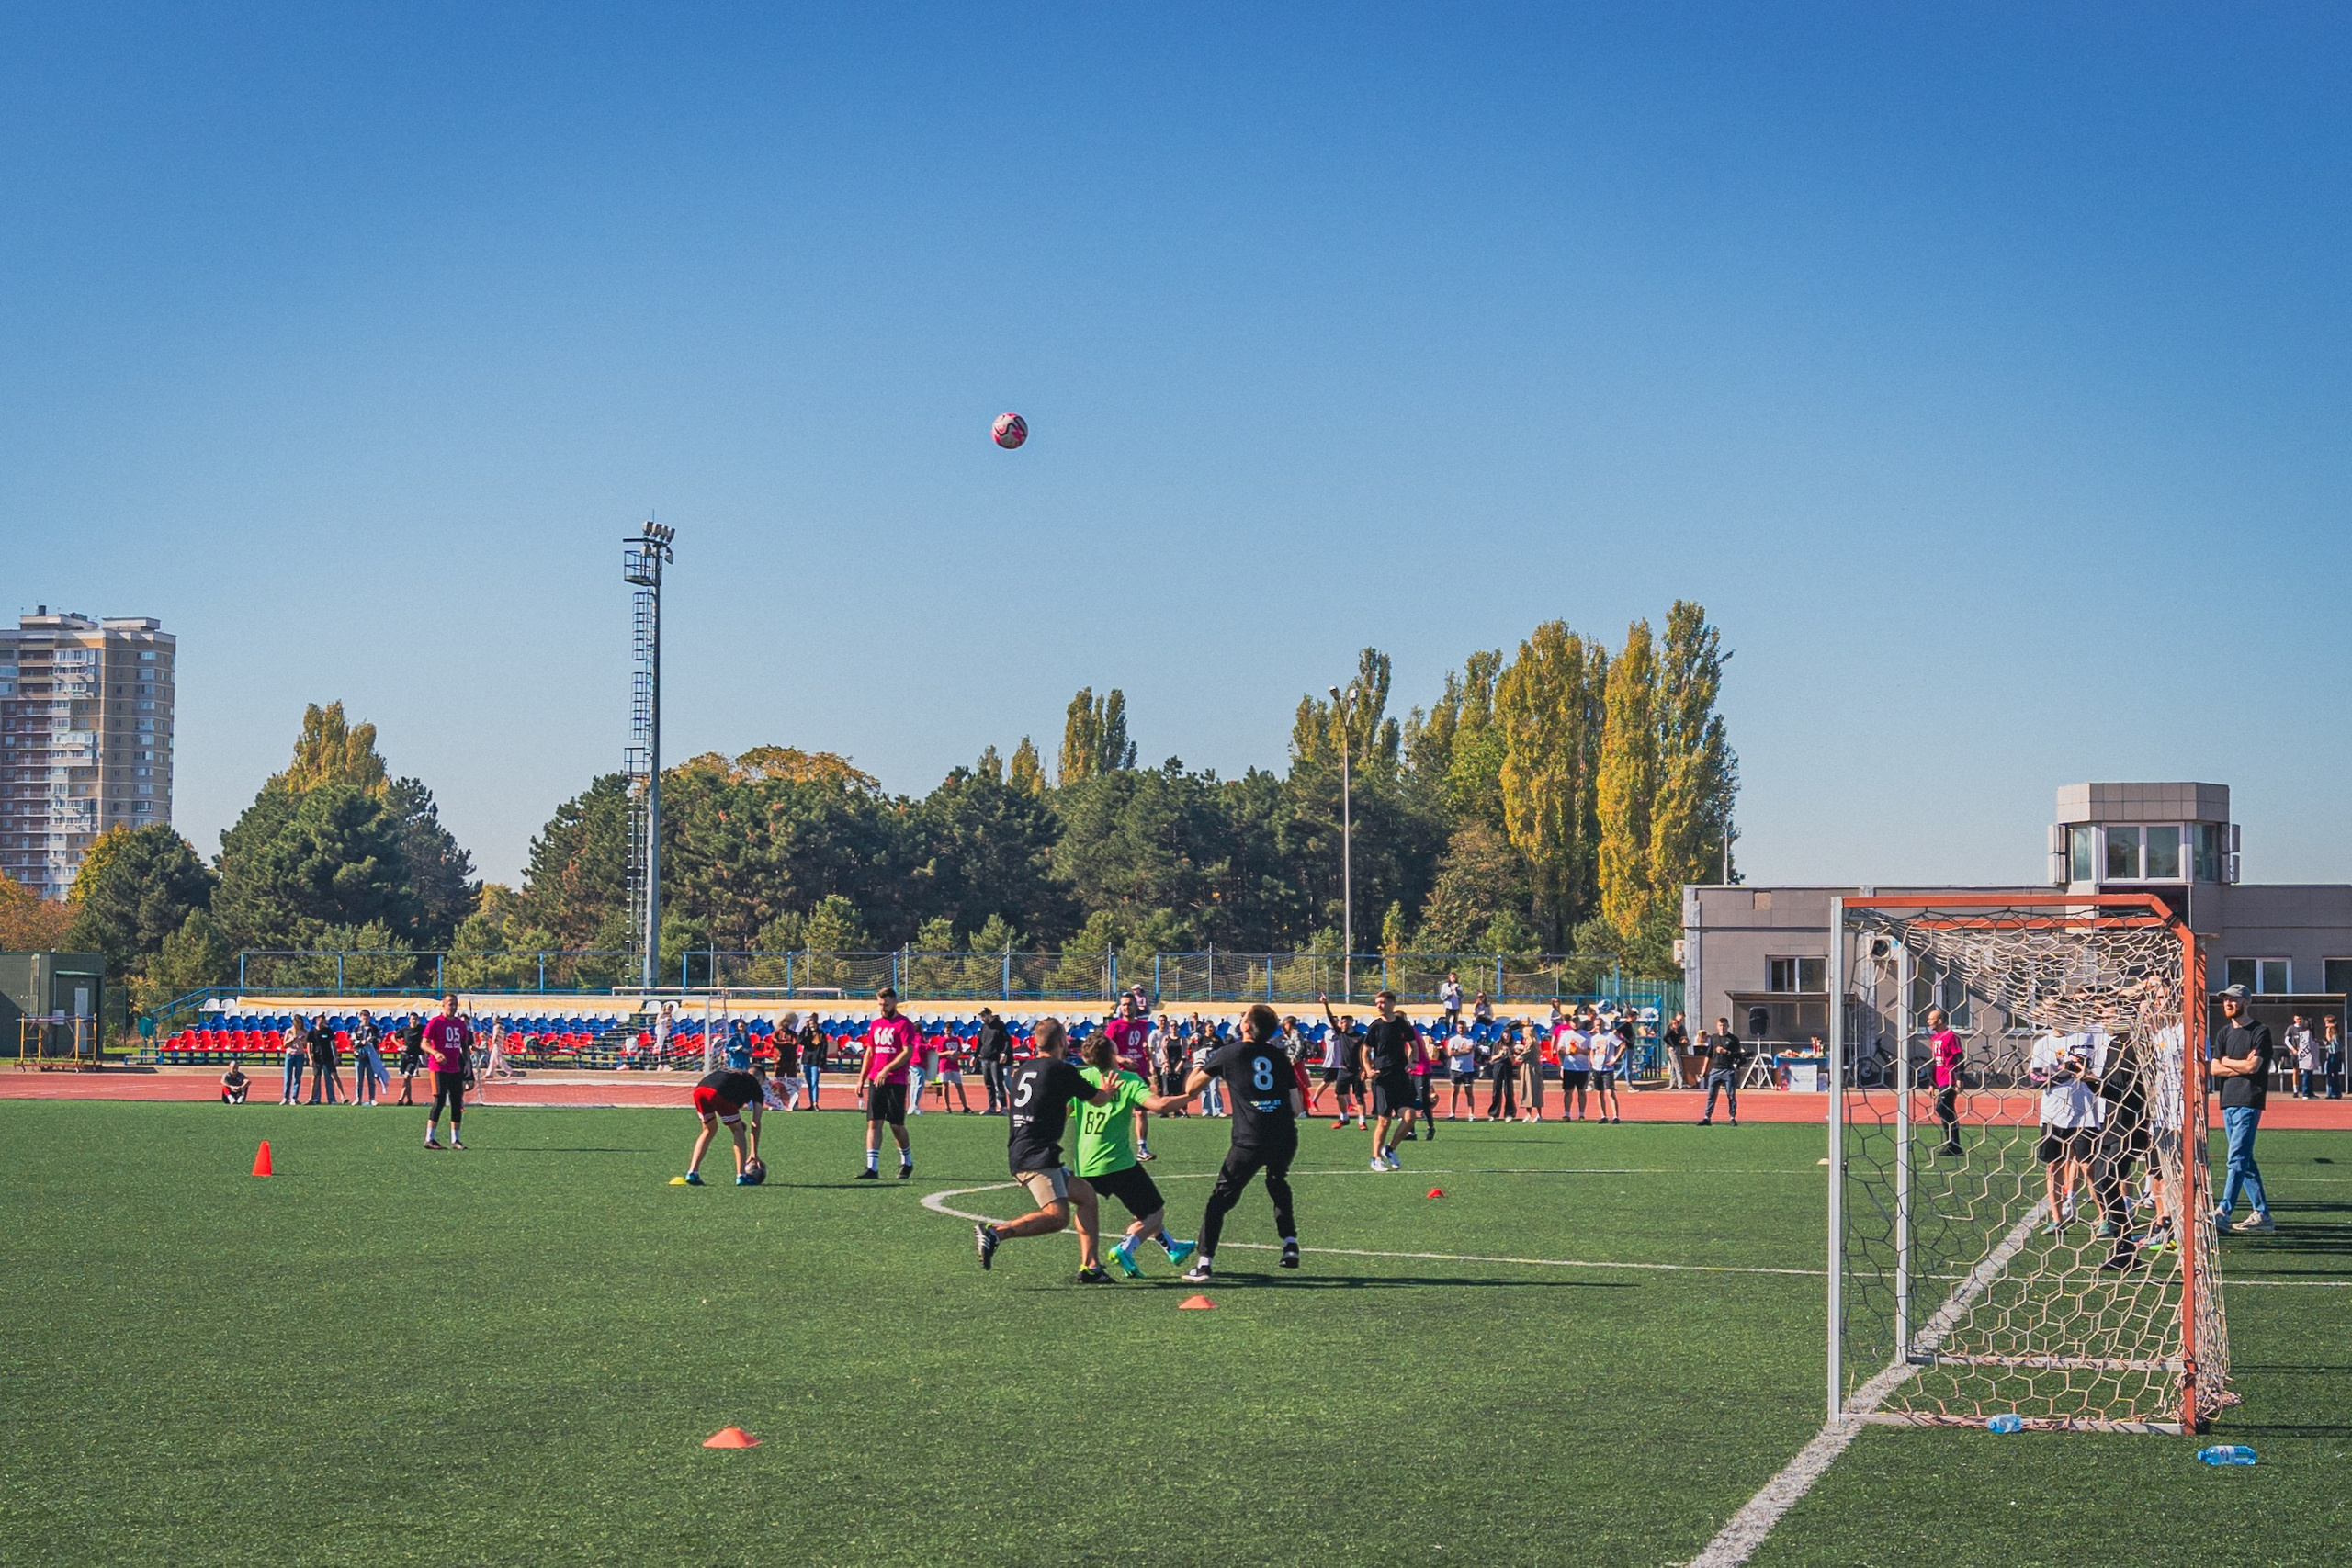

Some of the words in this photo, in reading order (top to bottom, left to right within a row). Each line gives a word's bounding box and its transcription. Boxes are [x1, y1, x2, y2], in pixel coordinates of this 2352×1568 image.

[446, 1026, 461, 1043] 05
[873, 1027, 896, 1045] 666
[1128, 1030, 1141, 1046] 69
[1253, 1056, 1274, 1091] 8
[1013, 1071, 1037, 1108] 5
[1084, 1111, 1106, 1135] 82
